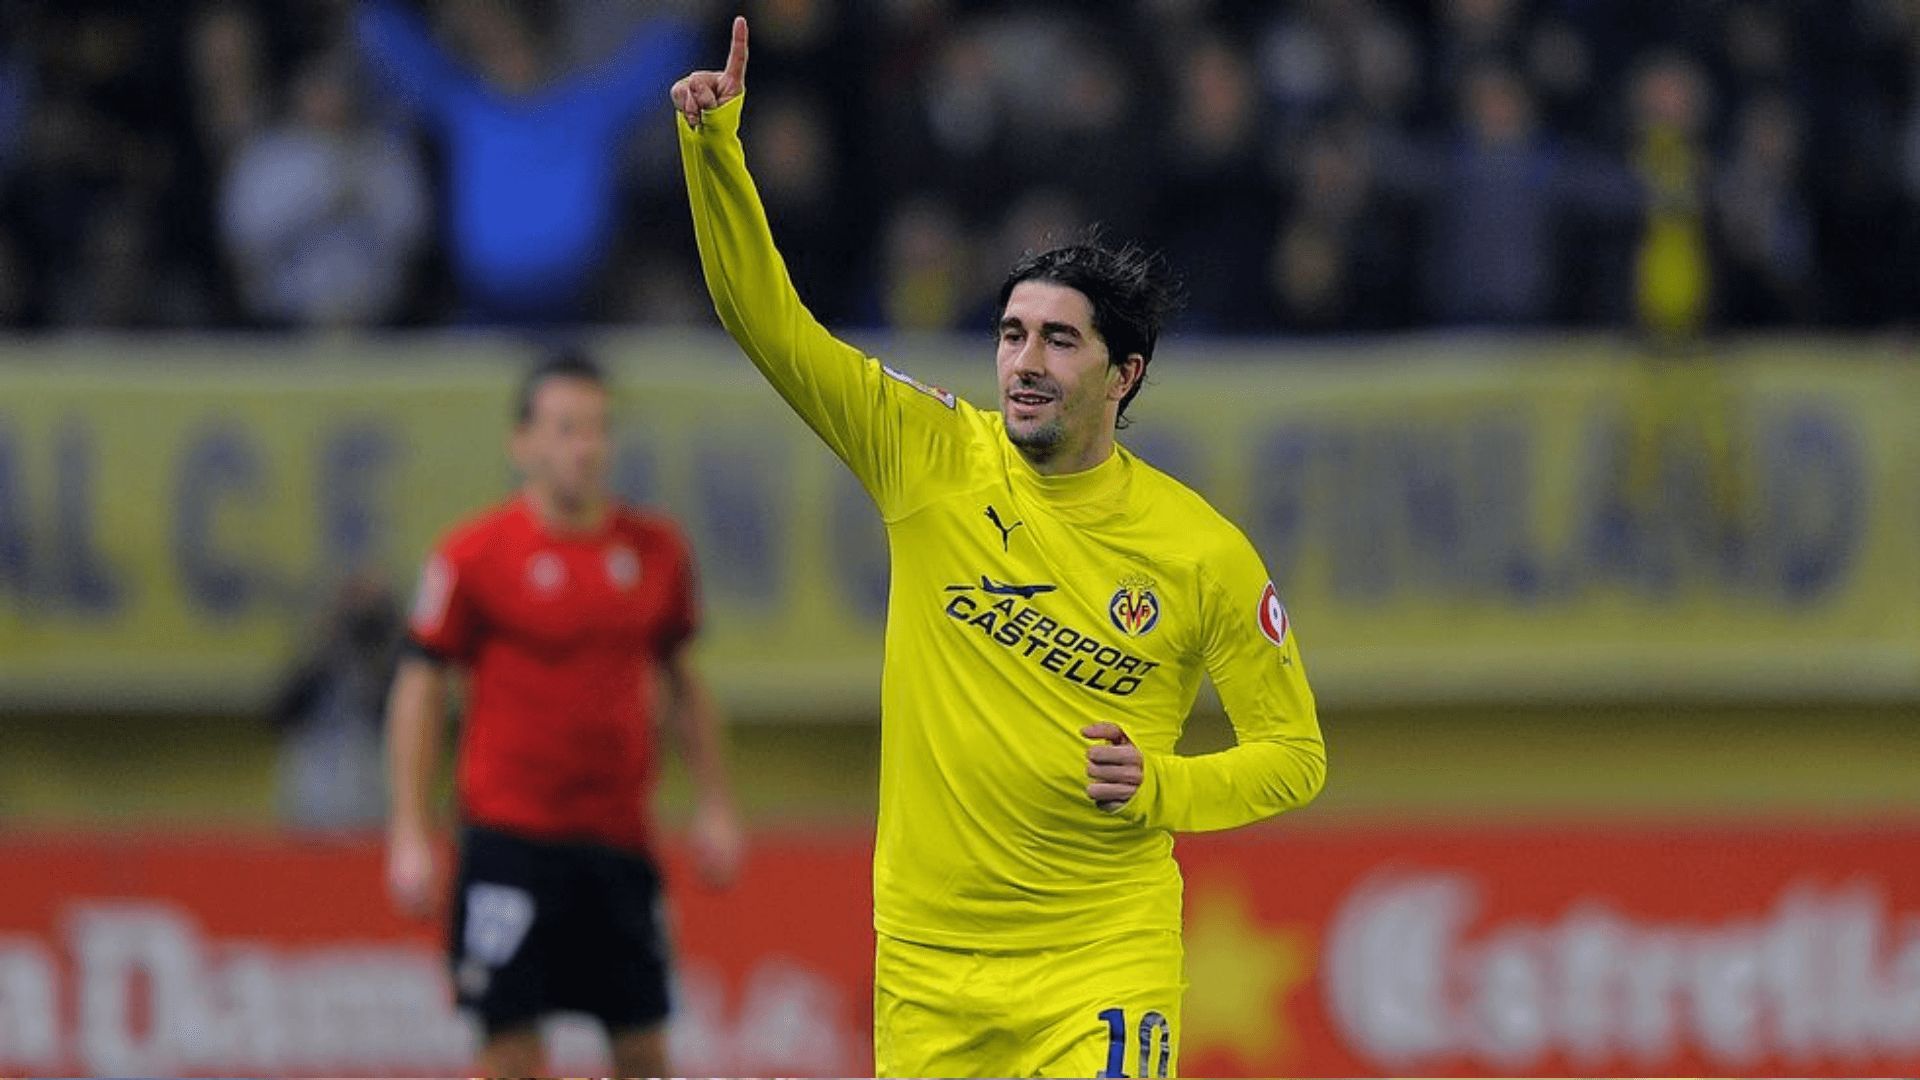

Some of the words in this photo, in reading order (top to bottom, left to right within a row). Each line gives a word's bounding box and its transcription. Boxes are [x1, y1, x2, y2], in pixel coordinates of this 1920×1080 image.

[945, 595, 1146, 696] CASTELLO
[992, 598, 1160, 675] AEROPORT
[1097, 1007, 1169, 1078] 10
